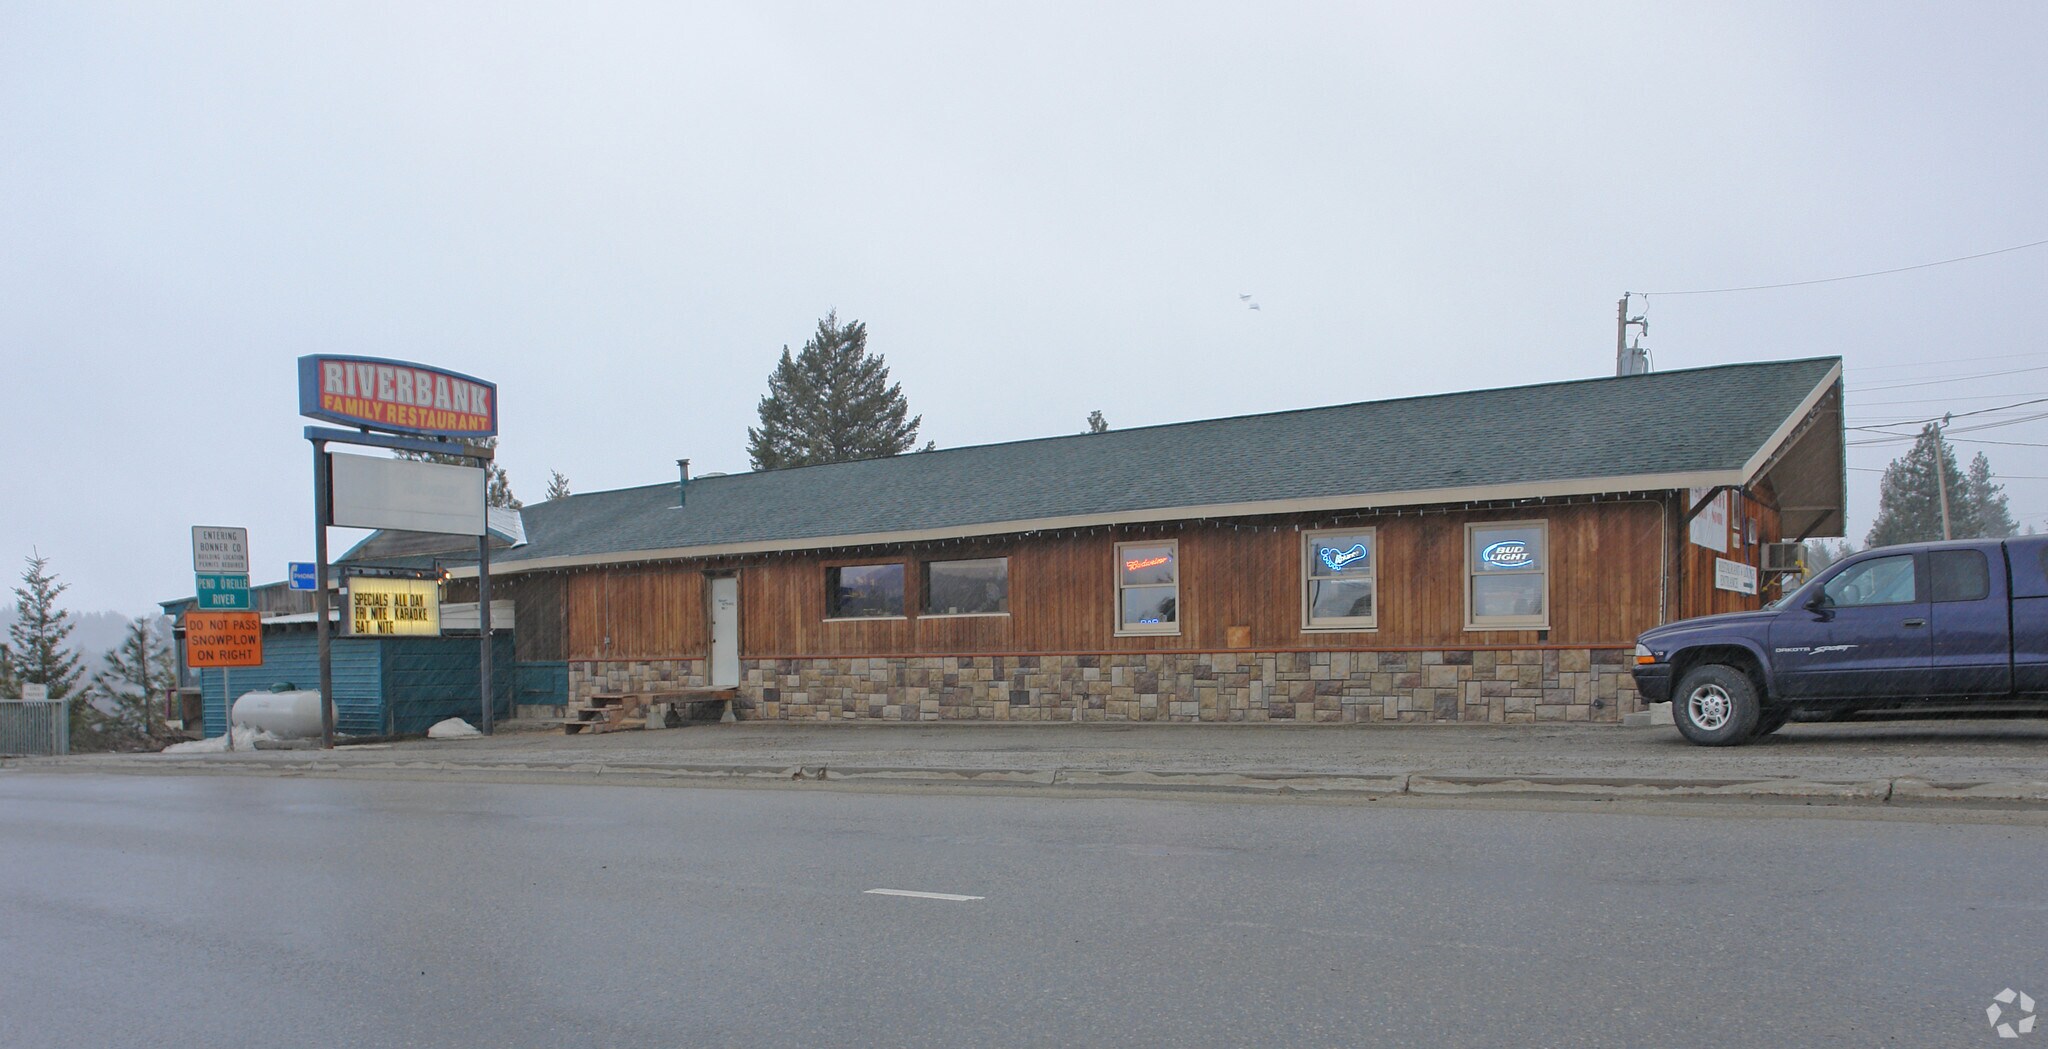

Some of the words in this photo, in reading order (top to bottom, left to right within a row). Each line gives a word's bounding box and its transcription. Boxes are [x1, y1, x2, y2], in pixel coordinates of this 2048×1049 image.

[323, 361, 488, 415] RIVERBANK
[324, 395, 383, 420] FAMILY
[387, 403, 487, 431] RESTAURANT
[203, 531, 237, 540] ENTERING
[200, 543, 228, 552] BONNER
[232, 543, 242, 552] CO
[1495, 546, 1525, 554] BUD
[1490, 553, 1530, 561] LIGHT
[199, 578, 215, 590] PEND
[212, 594, 236, 605] RIVER
[354, 592, 389, 606] SPECIALS
[394, 594, 408, 607] ALL
[410, 594, 424, 607] DAY
[355, 606, 367, 620] FRI
[371, 607, 388, 620] NITE
[394, 608, 428, 621] KARAOKE
[190, 620, 204, 631] DO
[209, 620, 228, 631] NOT
[233, 620, 257, 631] PASS
[355, 620, 370, 633] SAT
[377, 621, 394, 634] NITE
[191, 634, 256, 646] SNOWPLOW
[197, 650, 214, 661] ON
[219, 649, 253, 660] RIGHT
[1808, 644, 1859, 656] SPORT
